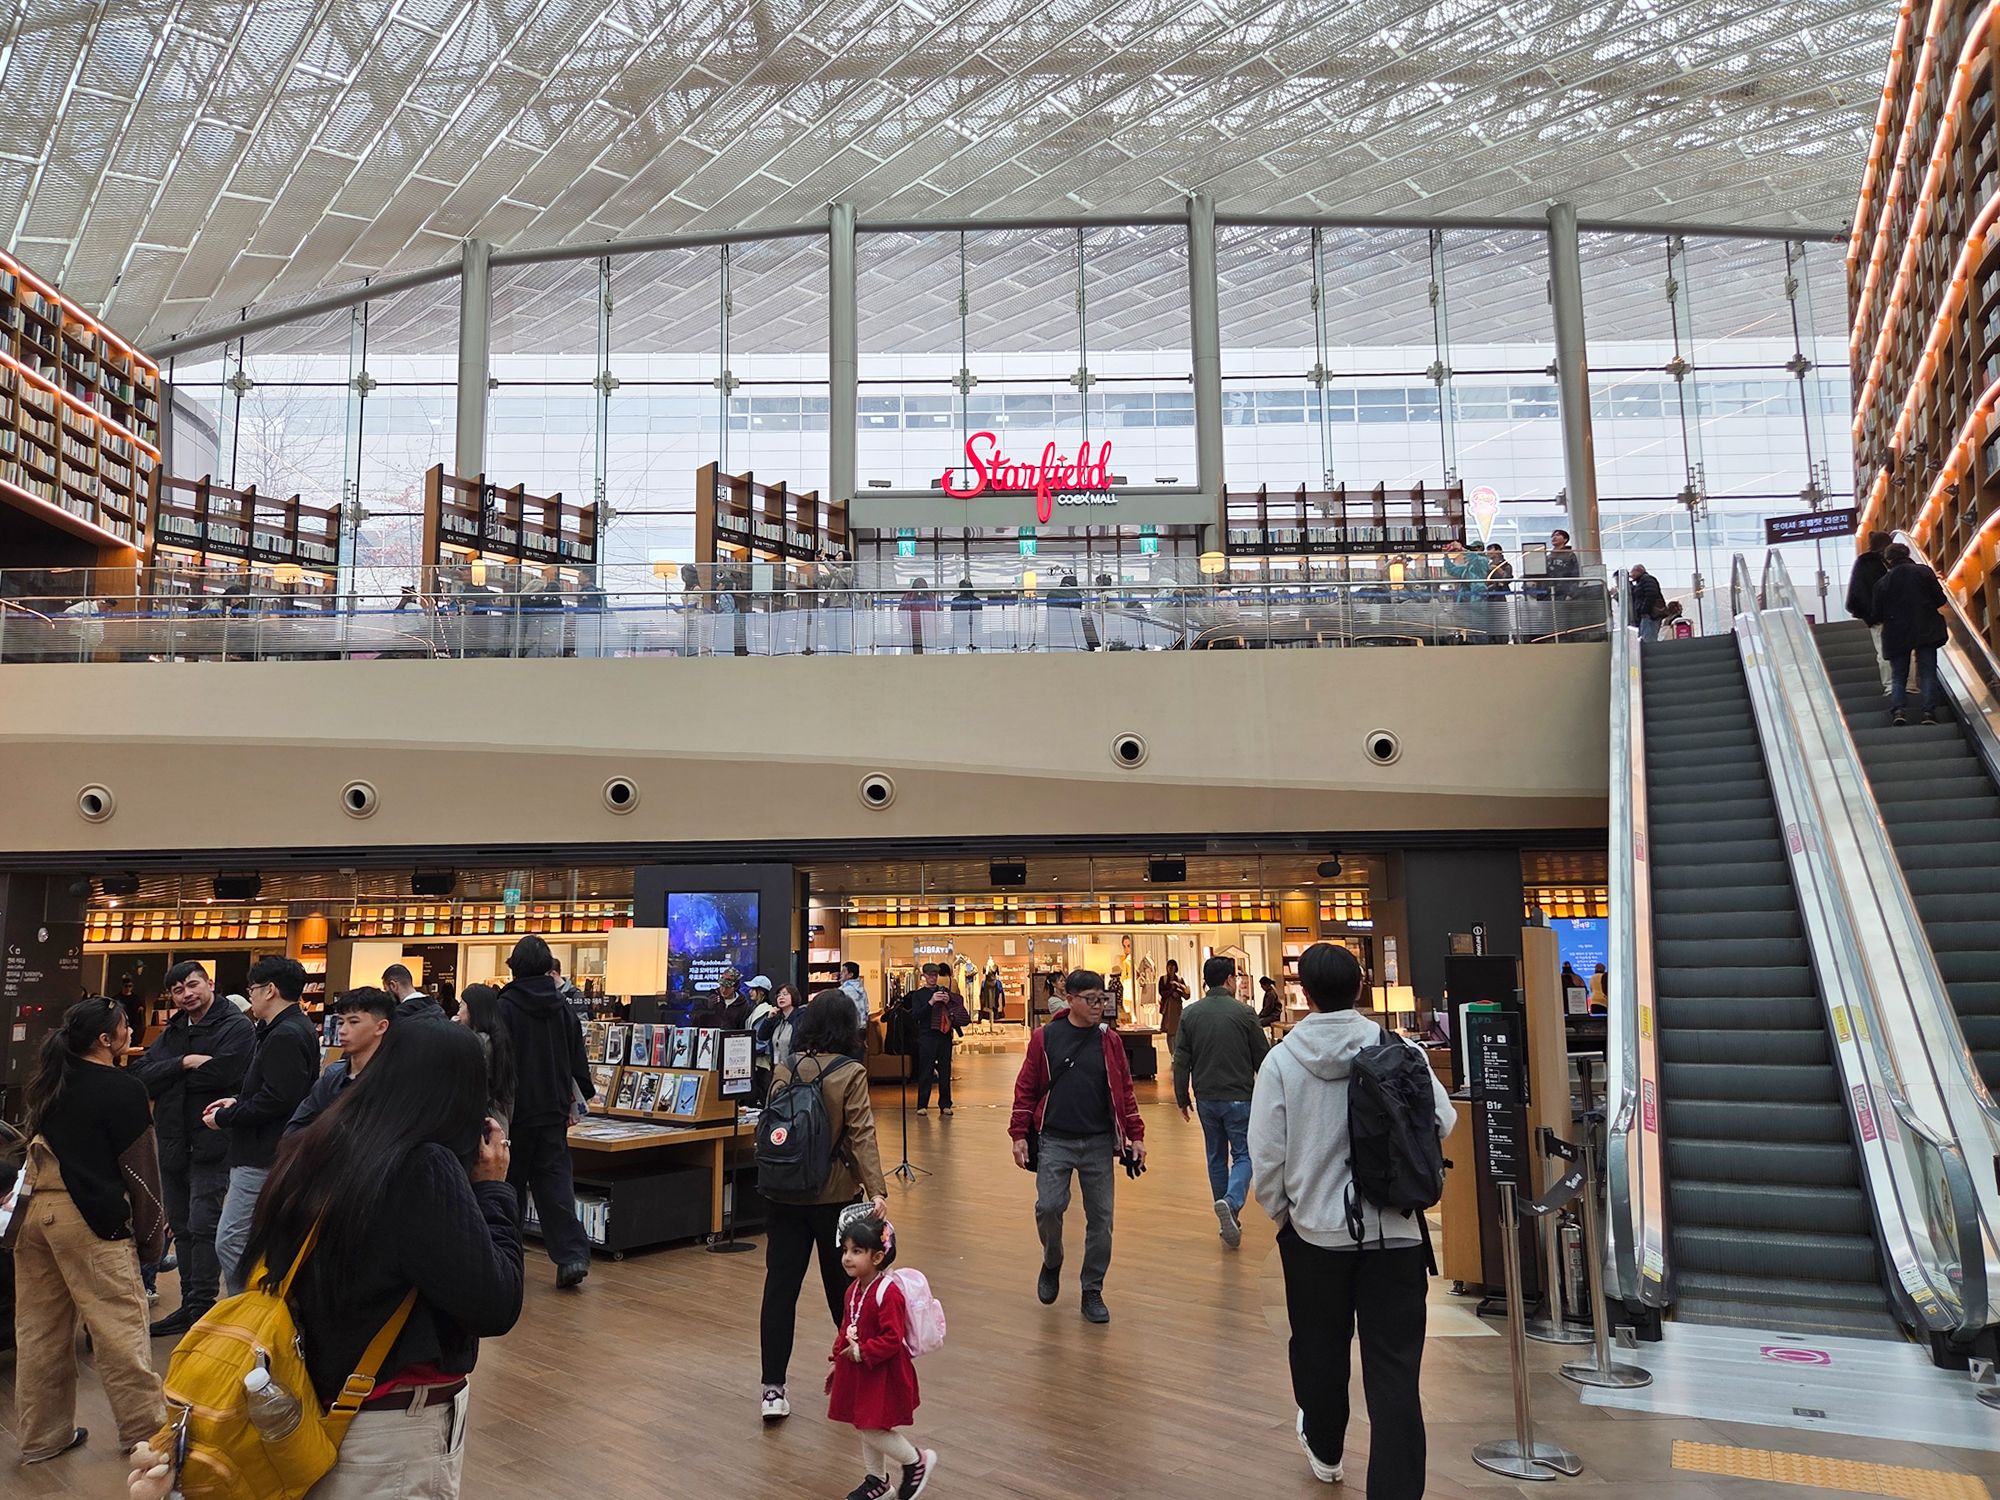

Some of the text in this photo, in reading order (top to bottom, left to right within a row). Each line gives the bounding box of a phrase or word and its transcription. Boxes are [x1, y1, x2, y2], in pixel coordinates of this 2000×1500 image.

[941, 431, 1113, 523] Starfield
[486, 489, 494, 506] G
[1090, 493, 1119, 505] MALL
[1824, 514, 1848, 524] 라운지
[1482, 1034, 1493, 1043] 1F
[1486, 1100, 1503, 1110] B1F
